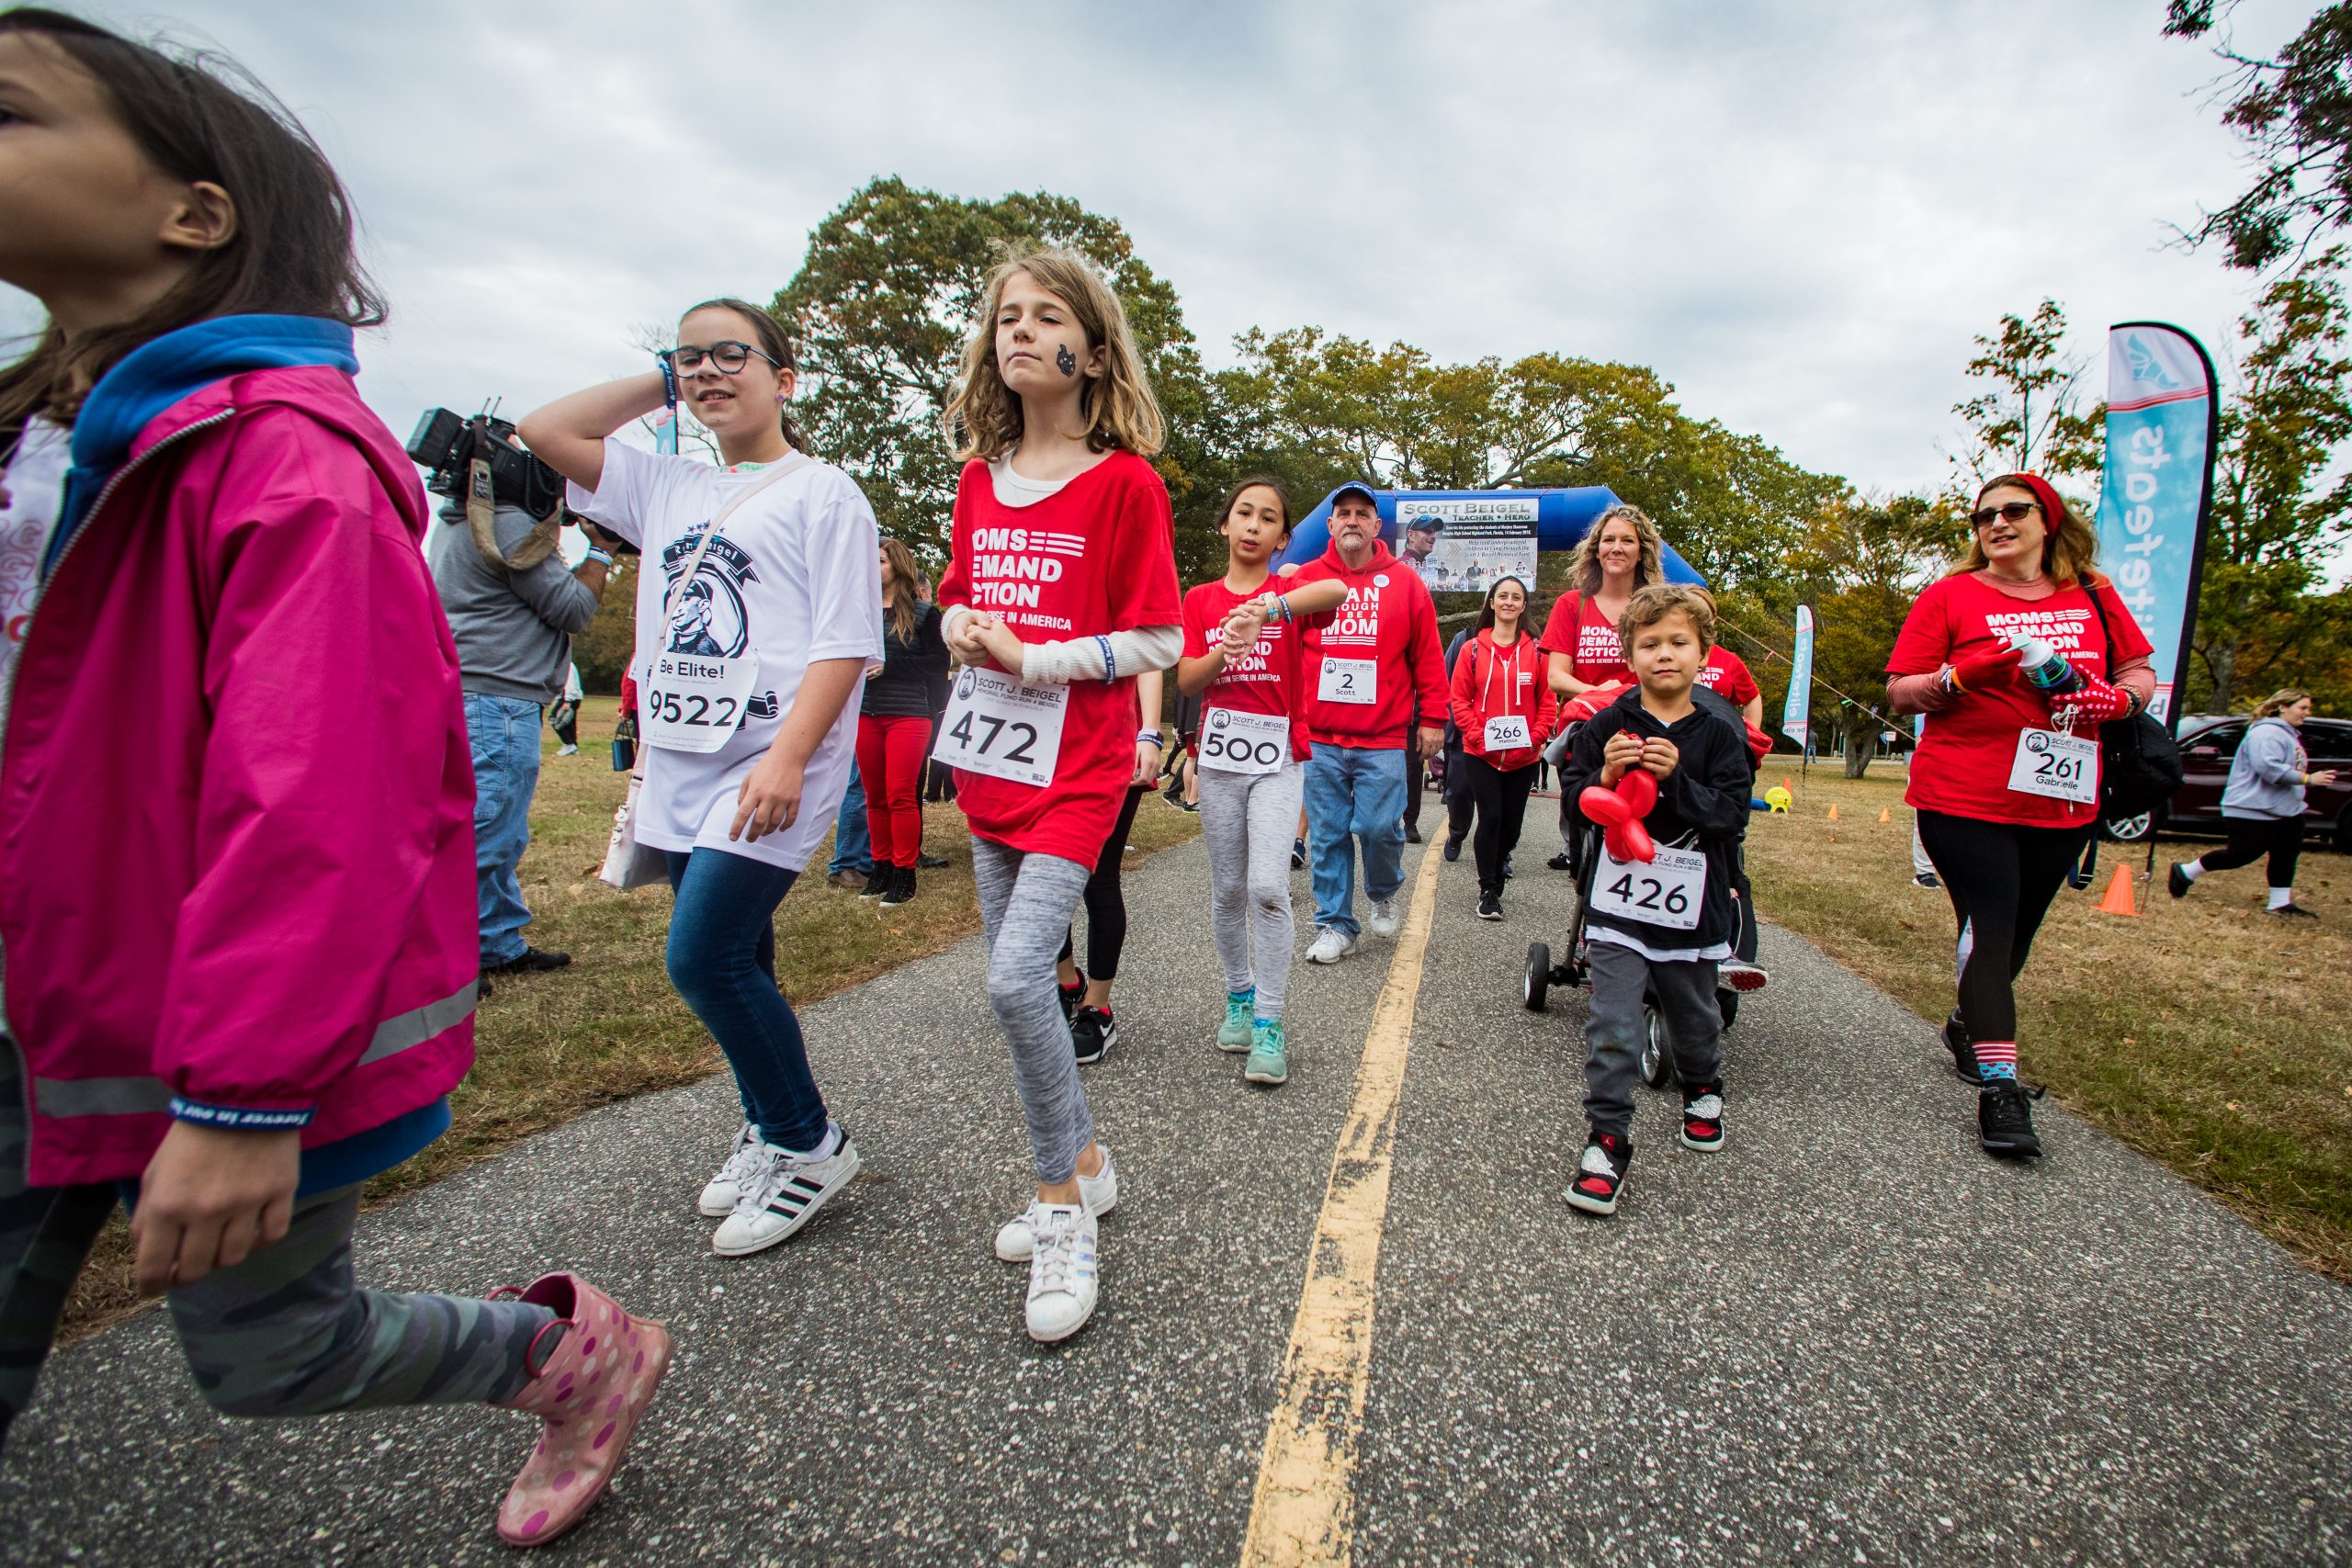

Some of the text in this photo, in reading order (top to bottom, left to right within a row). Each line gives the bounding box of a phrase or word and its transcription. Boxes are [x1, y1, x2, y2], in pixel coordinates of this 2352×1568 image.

[1404, 502, 1531, 514] SCOTT BEIGEL
[972, 527, 1028, 551] OMS
[972, 555, 1063, 582] EMAND
[1344, 587, 1380, 604] AN
[1336, 602, 1379, 612] OUGH
[1370, 610, 1378, 619] A
[1007, 611, 1018, 624] IN
[1019, 613, 1072, 631] AMERICA
[1984, 611, 2055, 626] MOMS
[1321, 618, 1378, 636] MOM
[1577, 647, 1620, 658] ACTIO
[2070, 651, 2099, 660] AMERICA
[660, 659, 725, 680] Be Elite!
[1250, 673, 1257, 682] IN
[1341, 673, 1353, 689] 2
[978, 677, 1062, 704] SCOTT J. BEIGEL
[1335, 688, 1356, 696] Scott
[650, 689, 739, 727] 9522
[1000, 693, 1018, 701] FUND
[1018, 696, 1033, 705] RUN
[1037, 700, 1059, 709] BEIGEL
[1232, 716, 1254, 725] SCOTT
[1262, 721, 1286, 729] BEIGEL
[949, 710, 1037, 765] 472
[1492, 726, 1521, 740] 266
[1204, 732, 1280, 766] 500
[2051, 738, 2073, 747] SCOTT
[2077, 743, 2095, 752] BEIGEL
[2033, 752, 2083, 781] 261
[1675, 856, 1704, 867] BEIGEL
[1607, 873, 1688, 915] 426
[183, 1105, 216, 1120] our
[216, 1110, 240, 1125] in
[240, 1112, 310, 1126] Forever
